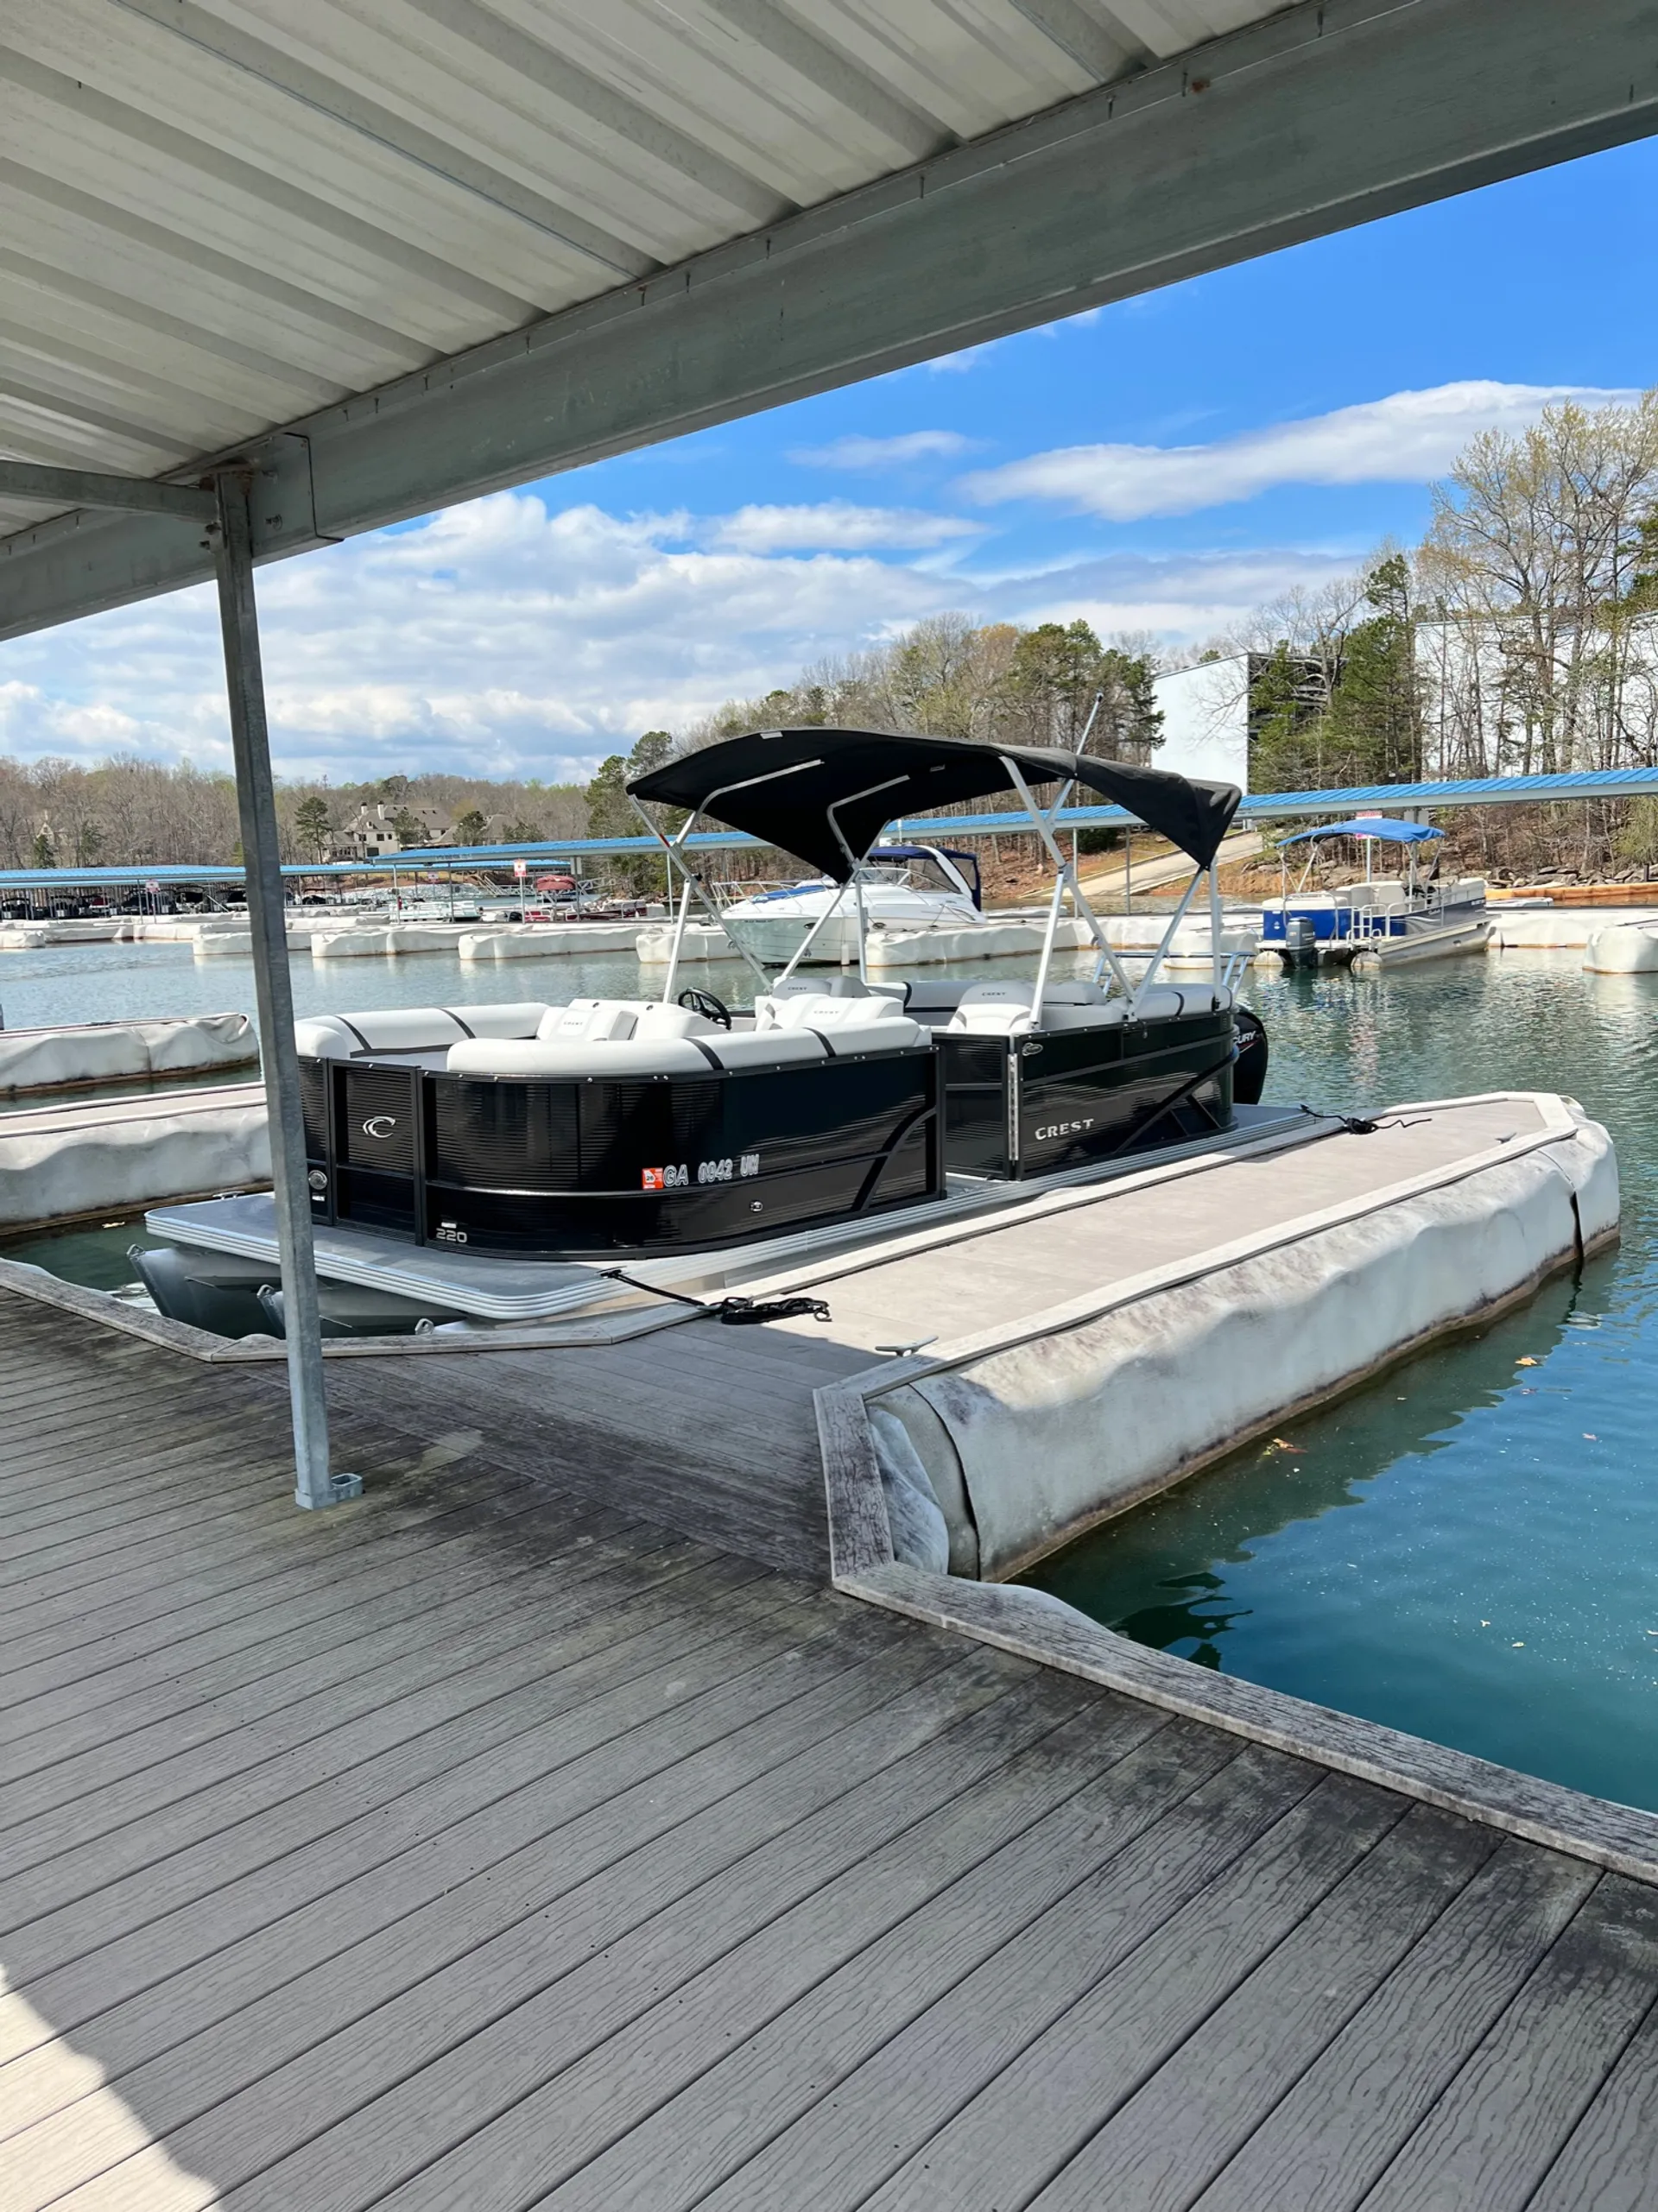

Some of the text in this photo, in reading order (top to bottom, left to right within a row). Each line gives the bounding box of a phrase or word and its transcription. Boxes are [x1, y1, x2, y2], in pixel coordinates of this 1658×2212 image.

[1233, 1030, 1256, 1045] CURY
[1035, 1118, 1094, 1140] CREST
[663, 1165, 688, 1186] GA
[436, 1228, 467, 1243] 220
